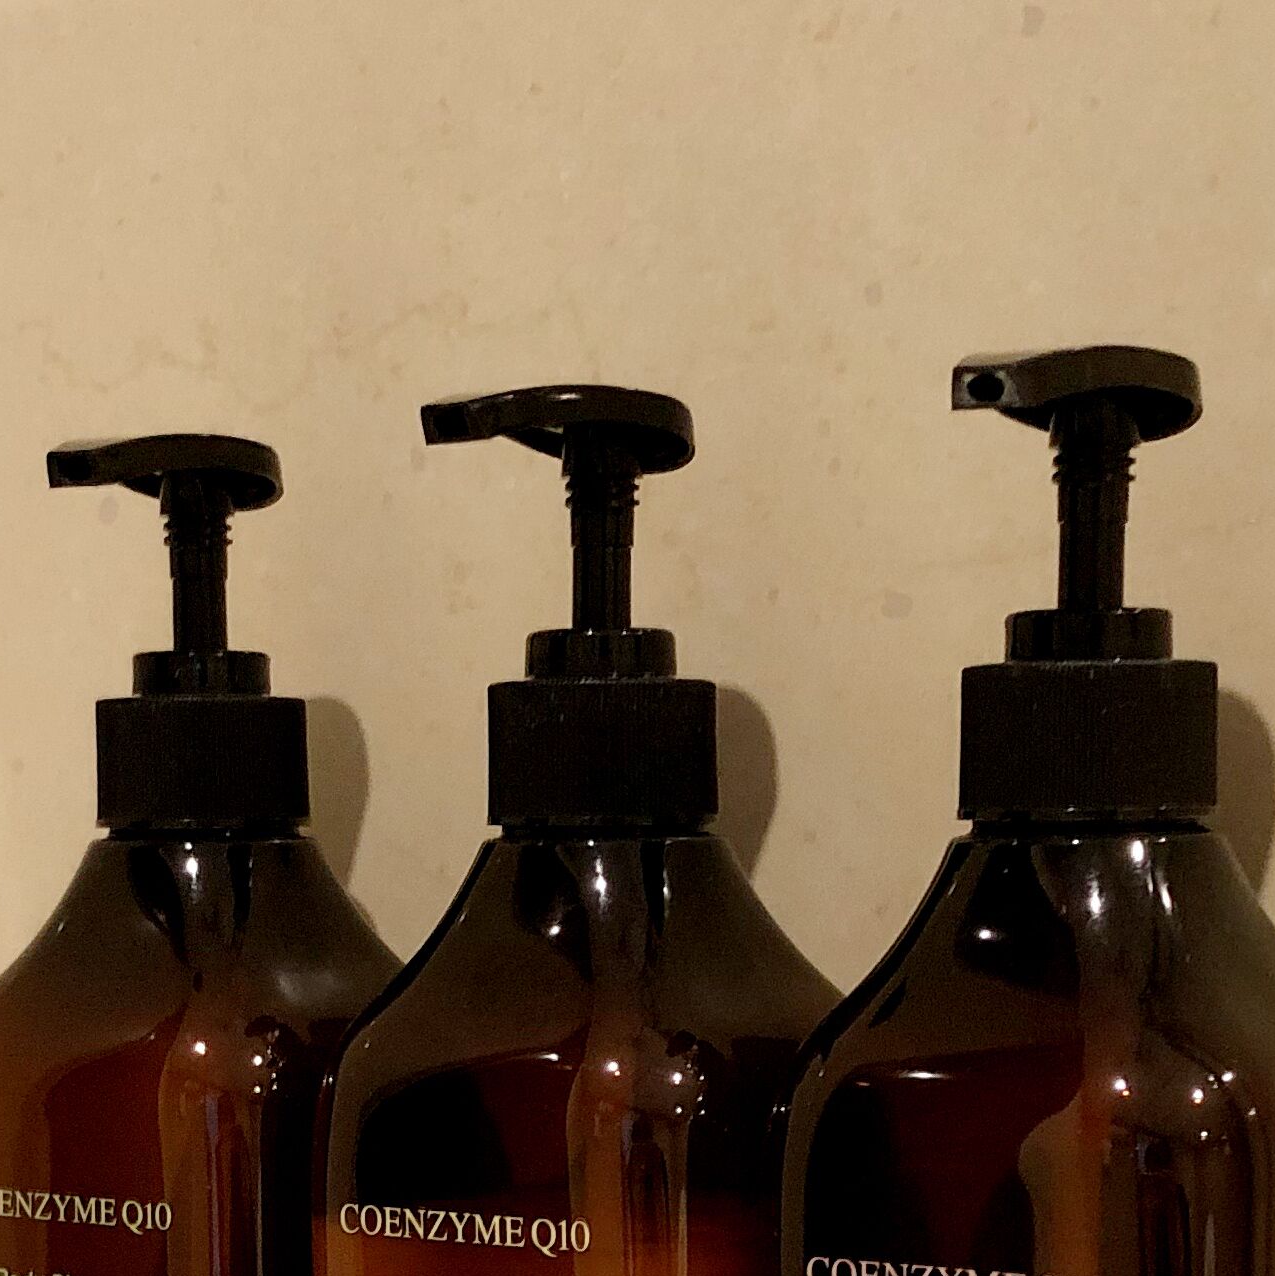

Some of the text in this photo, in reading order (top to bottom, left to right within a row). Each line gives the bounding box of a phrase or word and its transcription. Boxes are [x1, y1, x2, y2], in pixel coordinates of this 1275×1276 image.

[122, 1200, 172, 1235] Q10
[340, 1203, 590, 1257] COENZYME Q10
